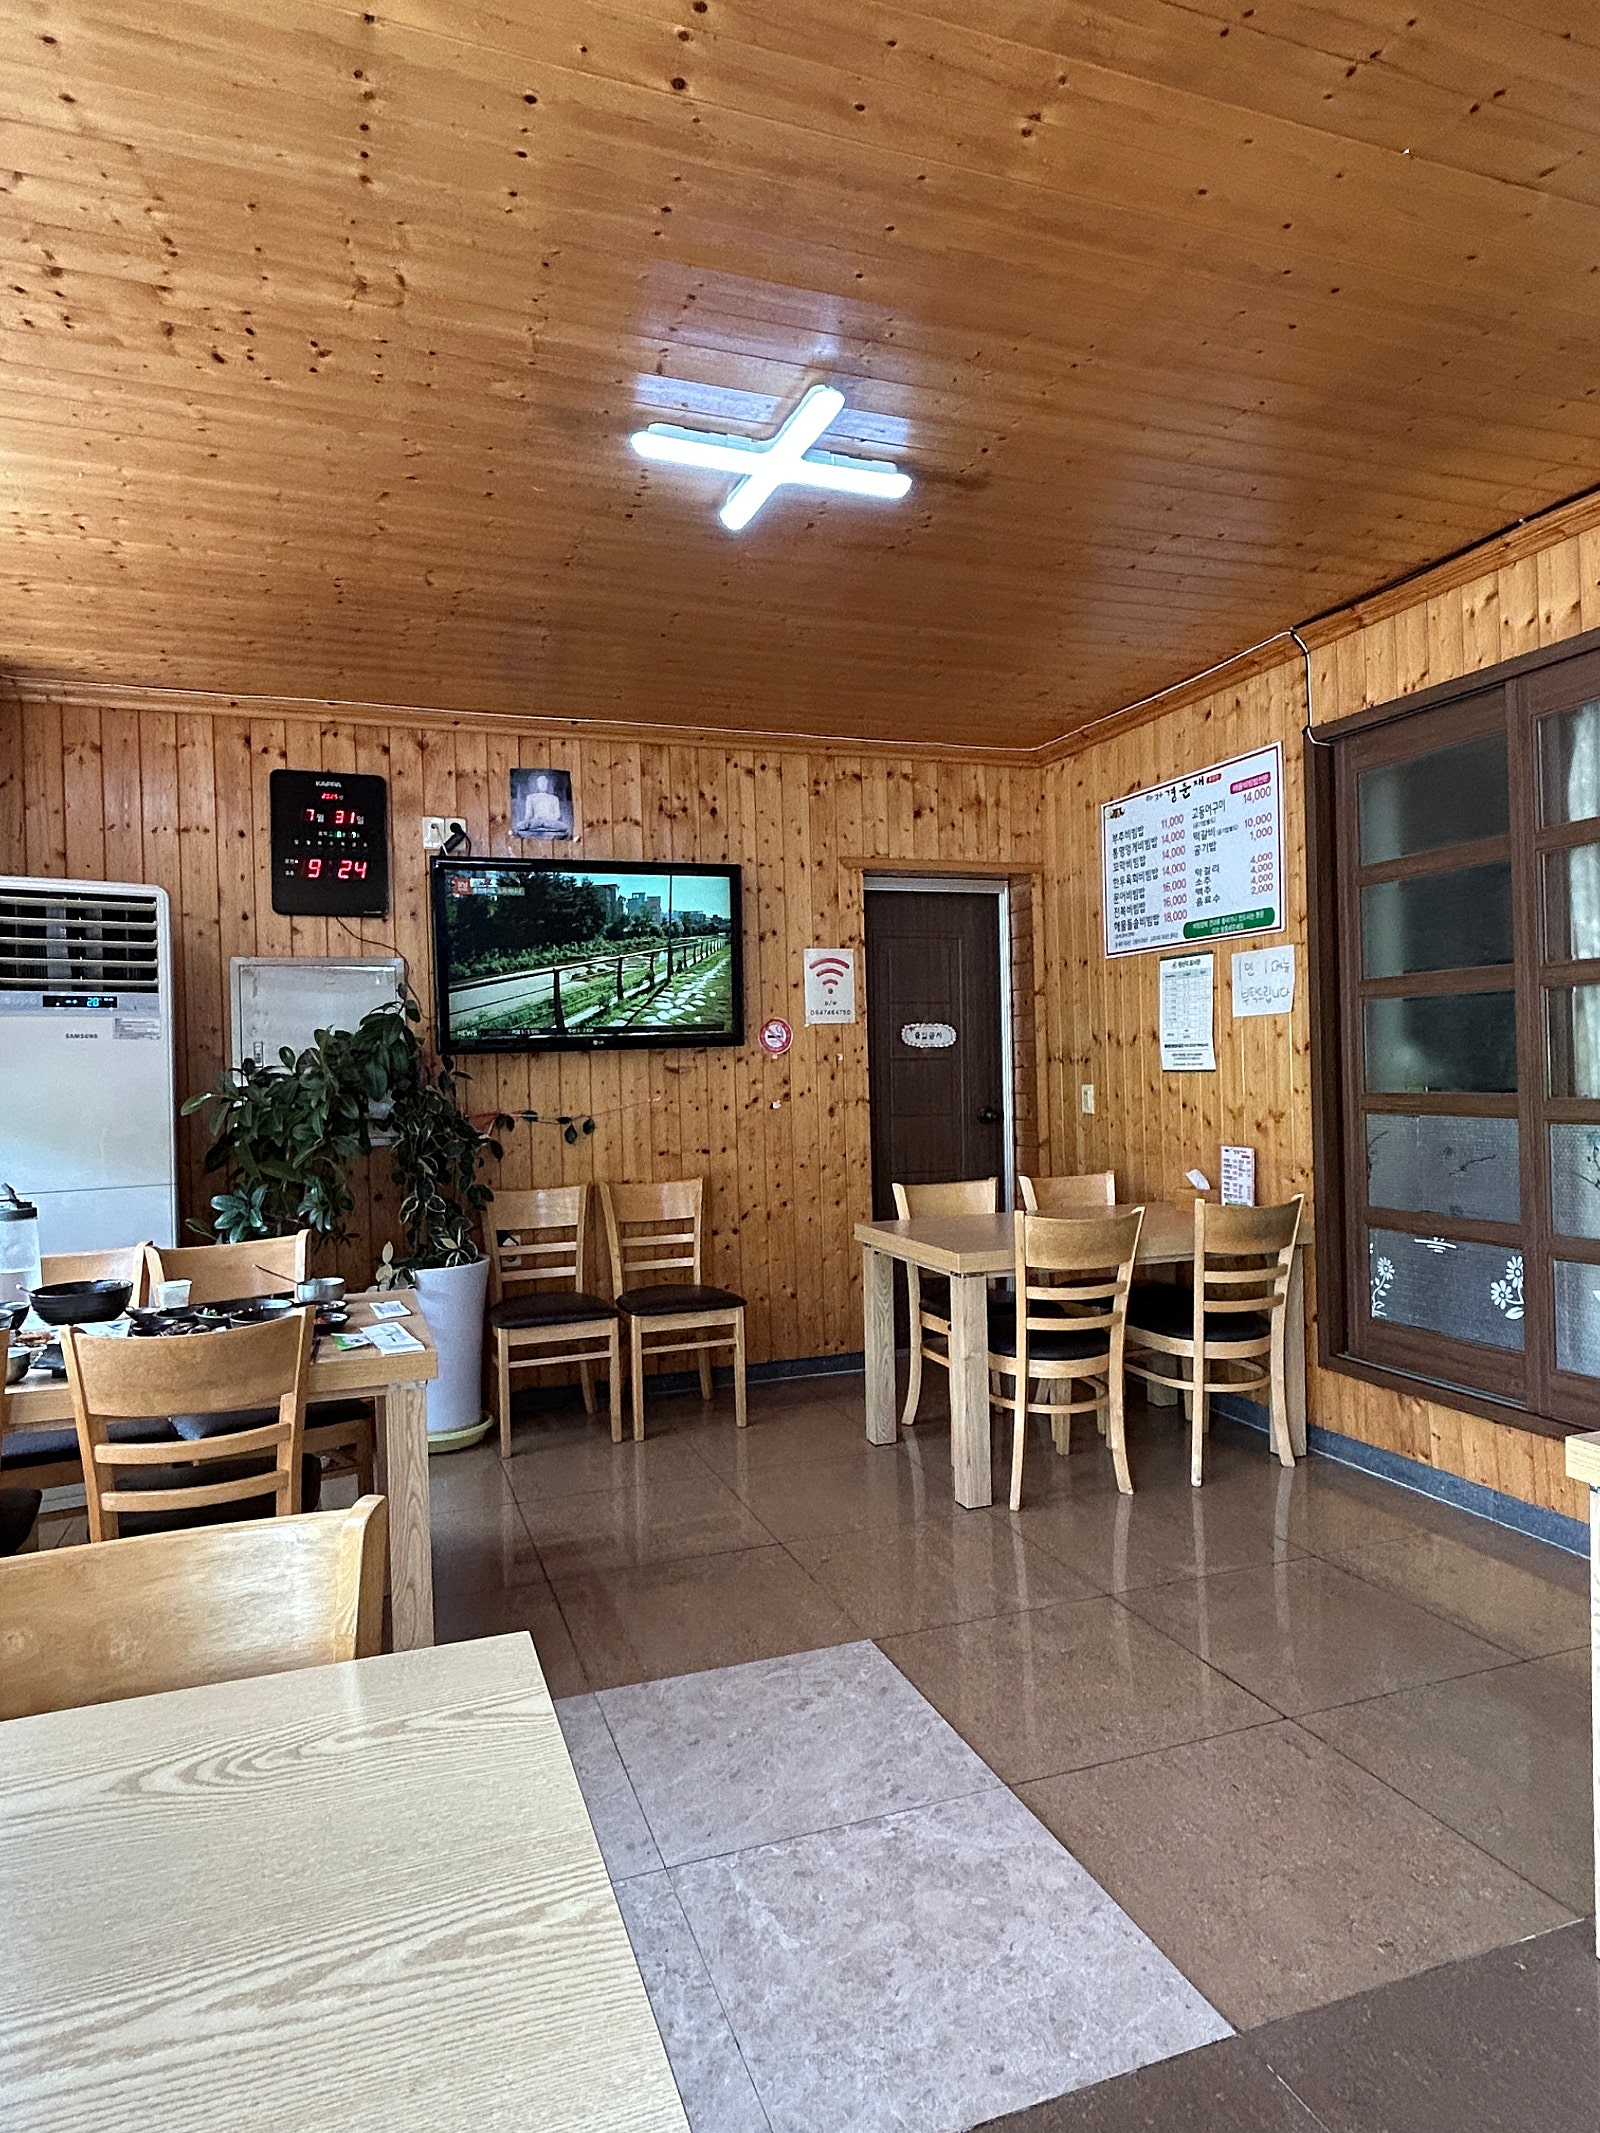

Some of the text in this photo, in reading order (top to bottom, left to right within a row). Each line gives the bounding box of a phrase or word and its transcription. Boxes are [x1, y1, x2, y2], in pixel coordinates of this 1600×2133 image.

[315, 780, 342, 788] KAPPA
[1166, 777, 1204, 804] 경운재
[1192, 786, 1272, 822] 고등어구이 14,000
[1113, 814, 1184, 845] 부추비빔밥 11,000
[1162, 830, 1185, 845] 14,000
[1193, 828, 1216, 842] 떡갈비
[1245, 813, 1272, 830] 10,000
[1194, 827, 1273, 856] 공기밥 1,000
[1163, 846, 1186, 861] 14,000
[307, 858, 367, 879] 9 24
[1163, 862, 1186, 877] 14,000
[1195, 852, 1273, 878] 막걸리 4,000
[1196, 863, 1273, 887] 소주 4,000
[1163, 879, 1187, 893] 16,000
[1196, 873, 1274, 897] 맥주 4,000
[1196, 883, 1274, 907] 음료수 2,000
[1164, 894, 1187, 908] 16,000
[1165, 910, 1188, 923] 18,000
[86, 997, 99, 1007] 28
